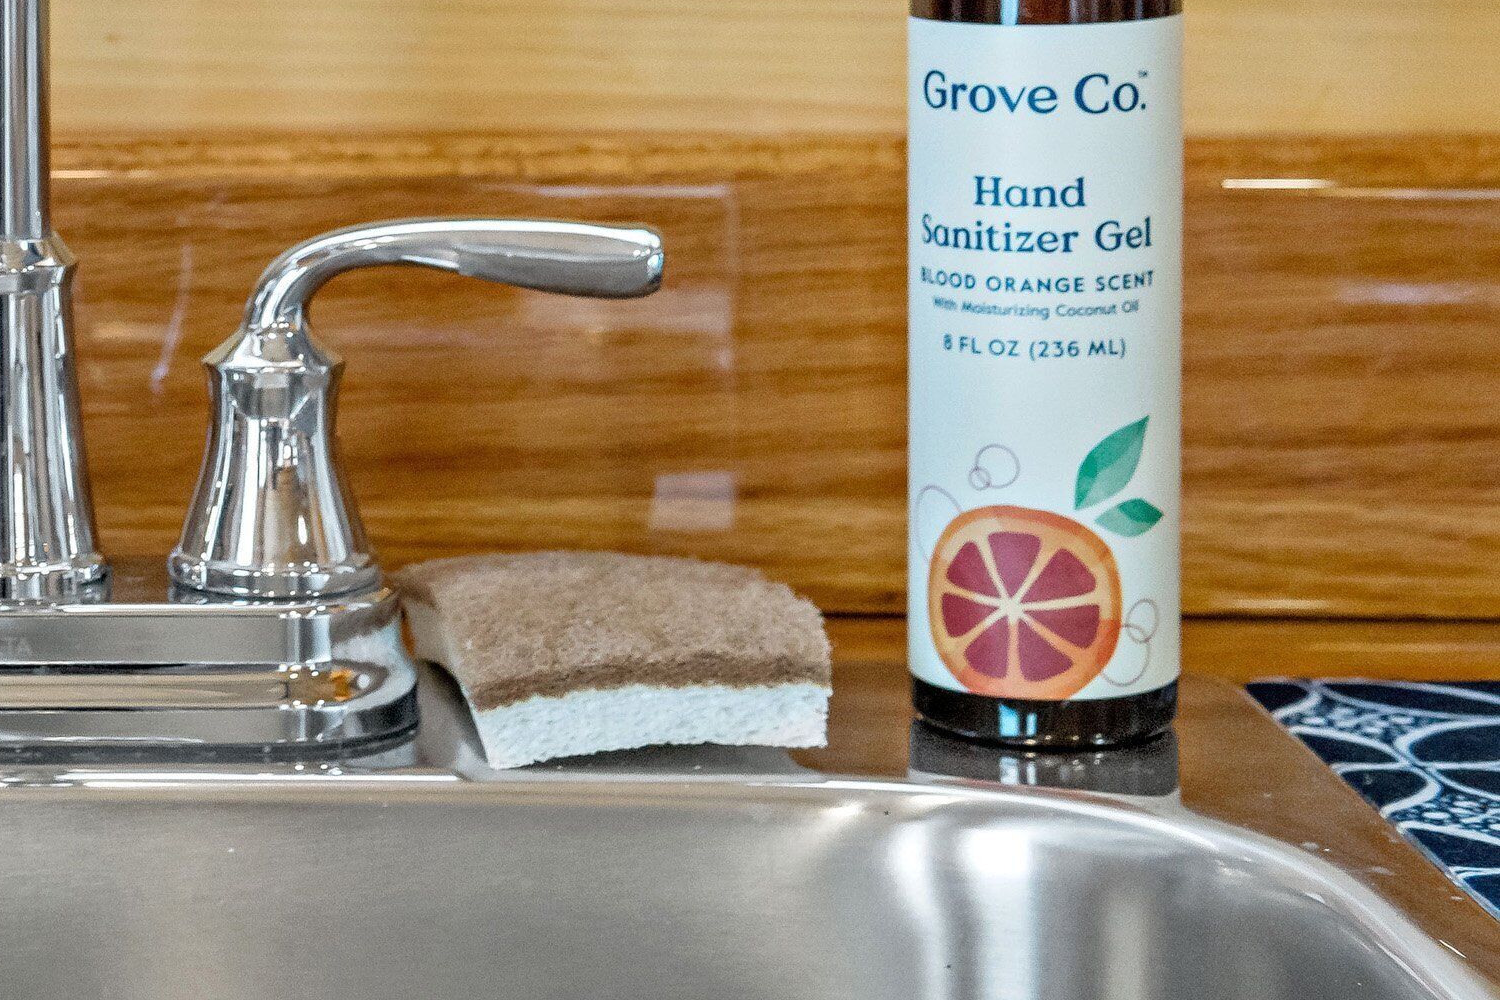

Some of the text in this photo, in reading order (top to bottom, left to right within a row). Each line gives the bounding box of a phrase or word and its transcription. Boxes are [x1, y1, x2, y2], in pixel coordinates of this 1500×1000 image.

[924, 70, 1058, 115] Grove
[973, 175, 1086, 208] Hand
[921, 213, 1153, 254] Sanitizer Gel
[920, 266, 1154, 293] BLOOD ORANGE SCENT
[932, 295, 1140, 320] With Moisturizing Coconut Oil
[943, 333, 1127, 361] 8 FL OZ (236 ML)
